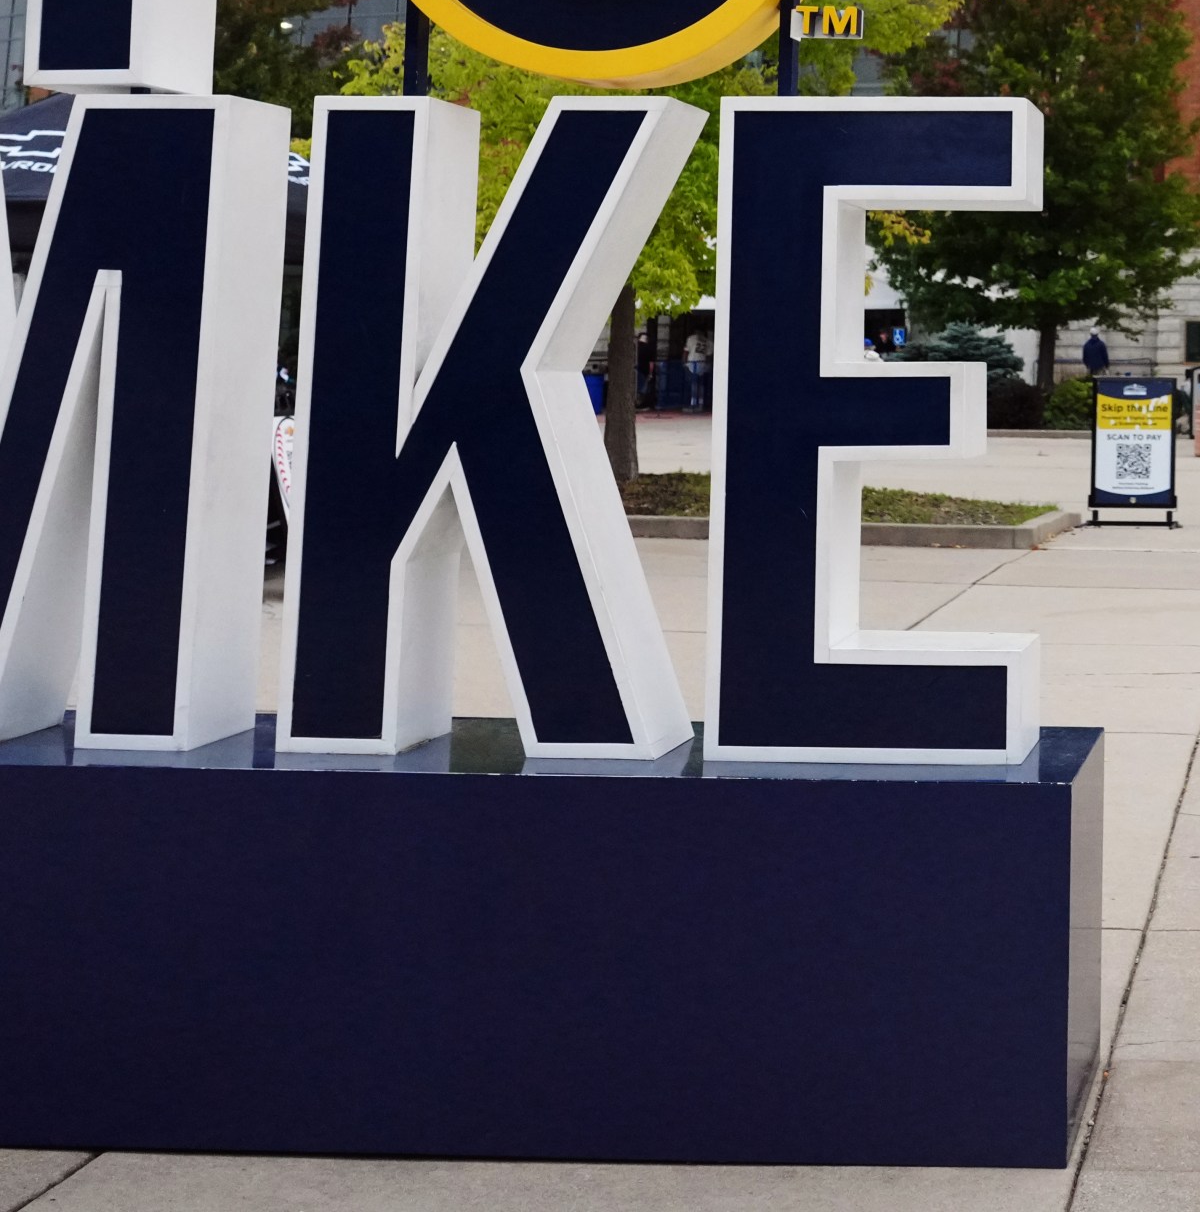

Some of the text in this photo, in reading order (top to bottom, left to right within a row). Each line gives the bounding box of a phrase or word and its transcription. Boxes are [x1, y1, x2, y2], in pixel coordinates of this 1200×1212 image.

[795, 5, 860, 37] TM
[1101, 403, 1123, 413] Skip
[1127, 403, 1142, 412] the
